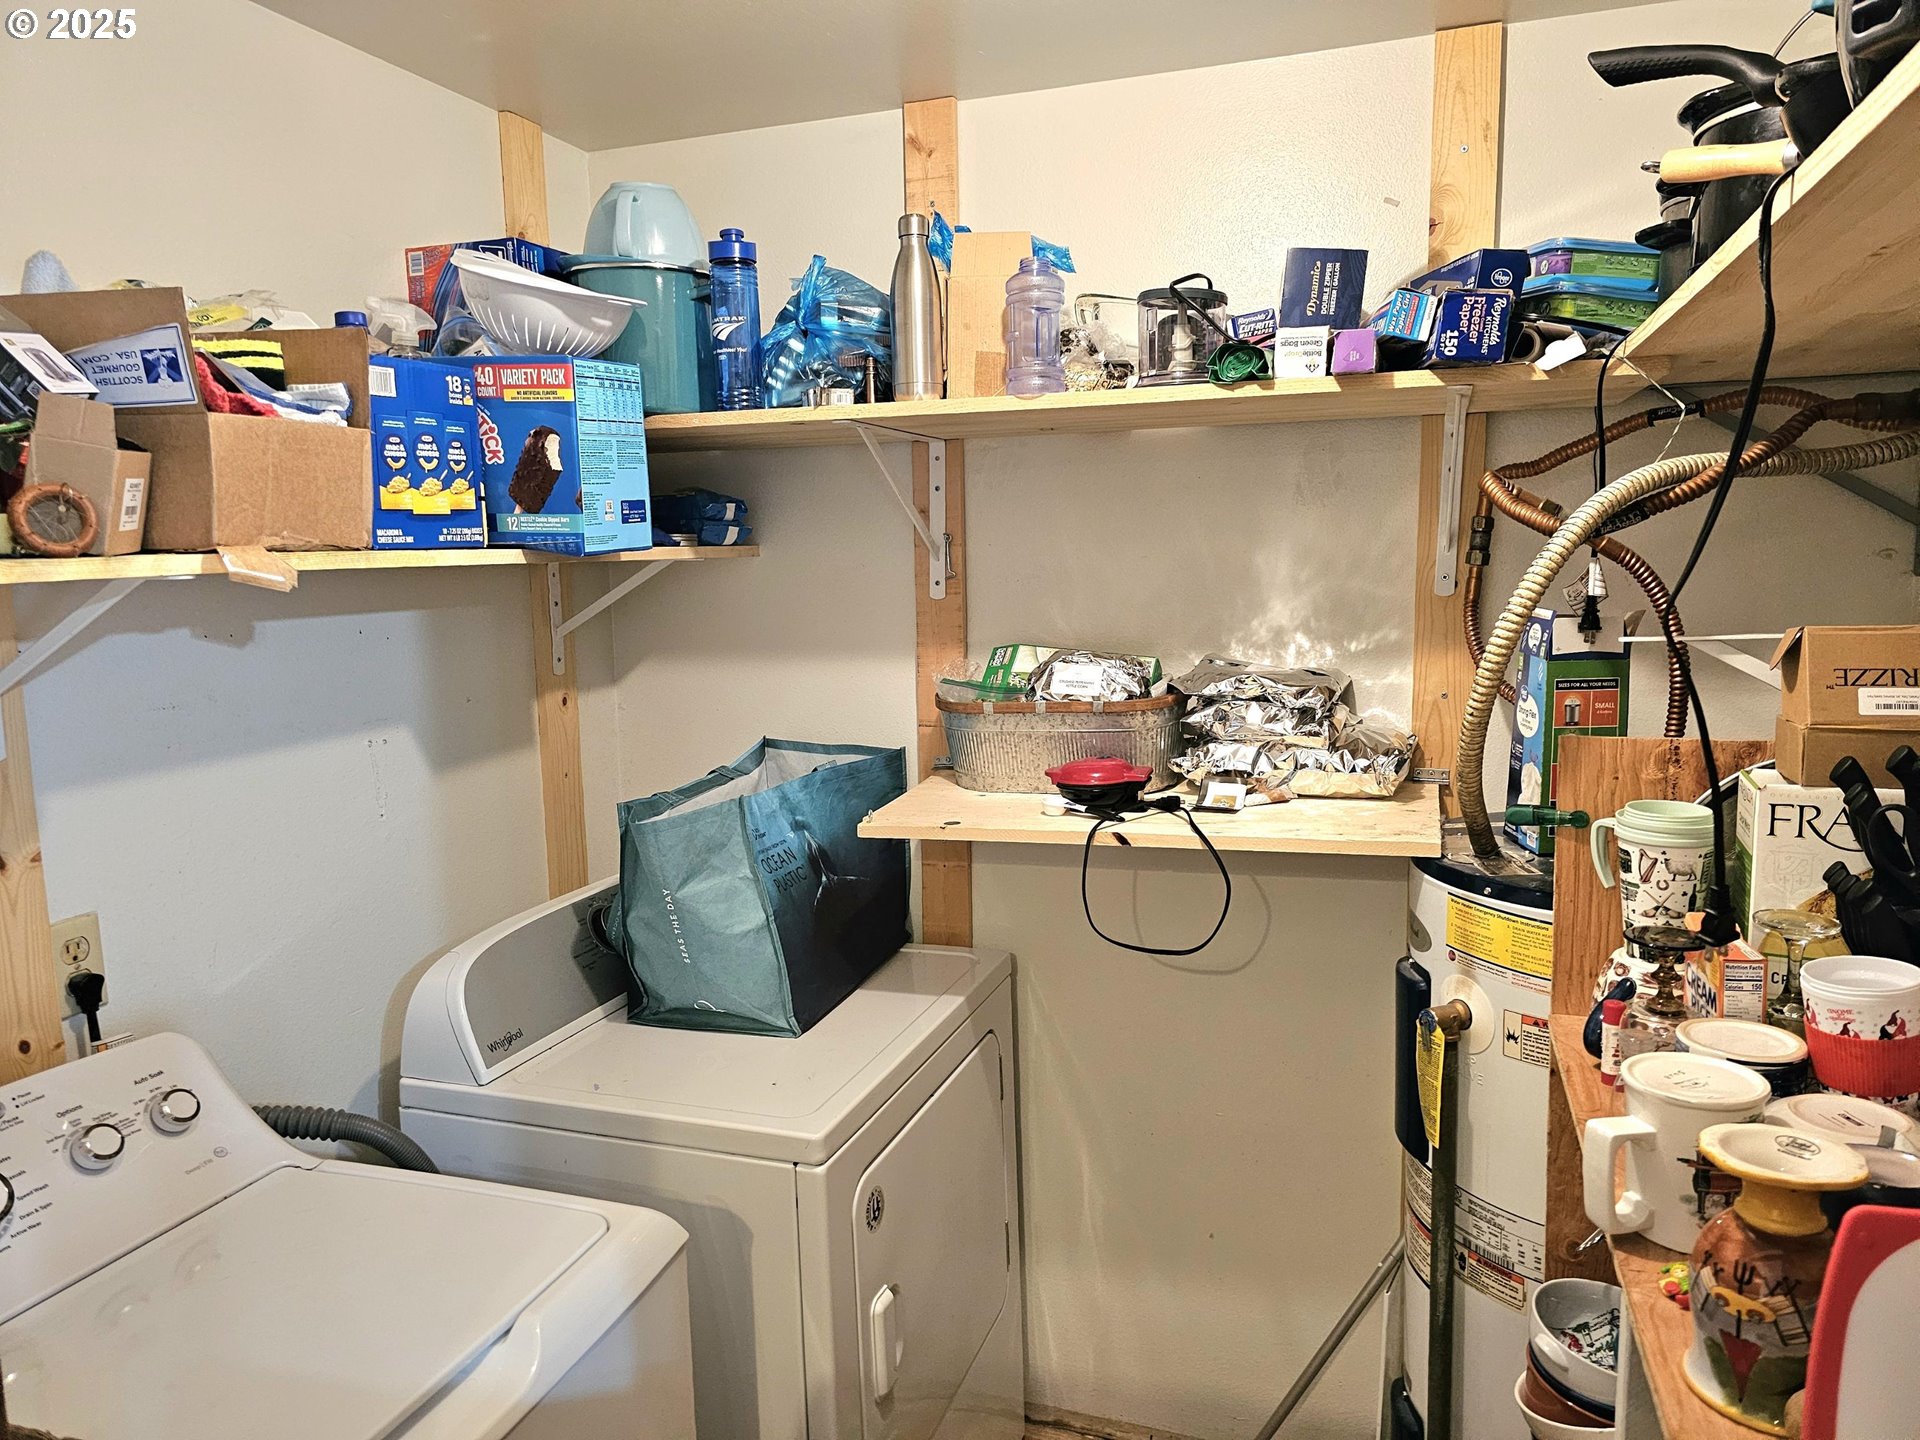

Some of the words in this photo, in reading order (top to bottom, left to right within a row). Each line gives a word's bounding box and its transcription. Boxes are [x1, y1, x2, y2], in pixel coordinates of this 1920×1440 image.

[1323, 262, 1333, 287] ZIPPER
[1329, 289, 1337, 315] FREEZER
[1333, 262, 1341, 286] GALLON
[1321, 287, 1330, 315] DOUBLE
[1388, 312, 1398, 332] Wax
[1393, 293, 1403, 312] Paper
[1395, 311, 1407, 334] Papier
[1459, 296, 1475, 333] Paper
[1469, 297, 1486, 344] Freezer
[1490, 297, 1507, 346] Reynolds
[1240, 320, 1275, 333] CUT-RITE
[1445, 330, 1459, 356] 150
[91, 363, 140, 374] GOURMET
[476, 367, 494, 386] 40
[500, 368, 538, 385] VARIETY
[540, 368, 566, 385] PACK
[95, 375, 144, 386] SCOTTISH
[445, 375, 462, 392] 18
[477, 386, 497, 397] COUNT
[507, 516, 519, 531] 12
[1766, 803, 1865, 851] FRA
[760, 846, 798, 875] OCEAN
[772, 864, 808, 895] PLASTIC
[662, 888, 675, 910] DAY
[669, 914, 682, 935] THE
[1473, 906, 1496, 918] Emergency
[1496, 913, 1519, 925] Shutdown
[1519, 920, 1550, 932] Instructions
[1512, 925, 1526, 933] DRAIN
[677, 938, 691, 964] SEAS
[1686, 961, 1717, 1014] CREAM
[1751, 983, 1762, 991] 150
[487, 1027, 524, 1053] Whirlpool
[133, 1075, 149, 1086] Auto
[149, 1069, 164, 1080] Soak
[17, 1091, 32, 1099] Pause
[29, 1094, 46, 1103] Locked
[56, 1103, 84, 1118] Options
[9, 1169, 27, 1180] asuals
[16, 1190, 34, 1202] Speed
[33, 1183, 49, 1194] Wash
[19, 1209, 35, 1221] Drain
[40, 1201, 53, 1211] Spin
[10, 1228, 28, 1240] Active
[27, 1220, 42, 1231] Wear
[1480, 1257, 1512, 1279] WARNING
